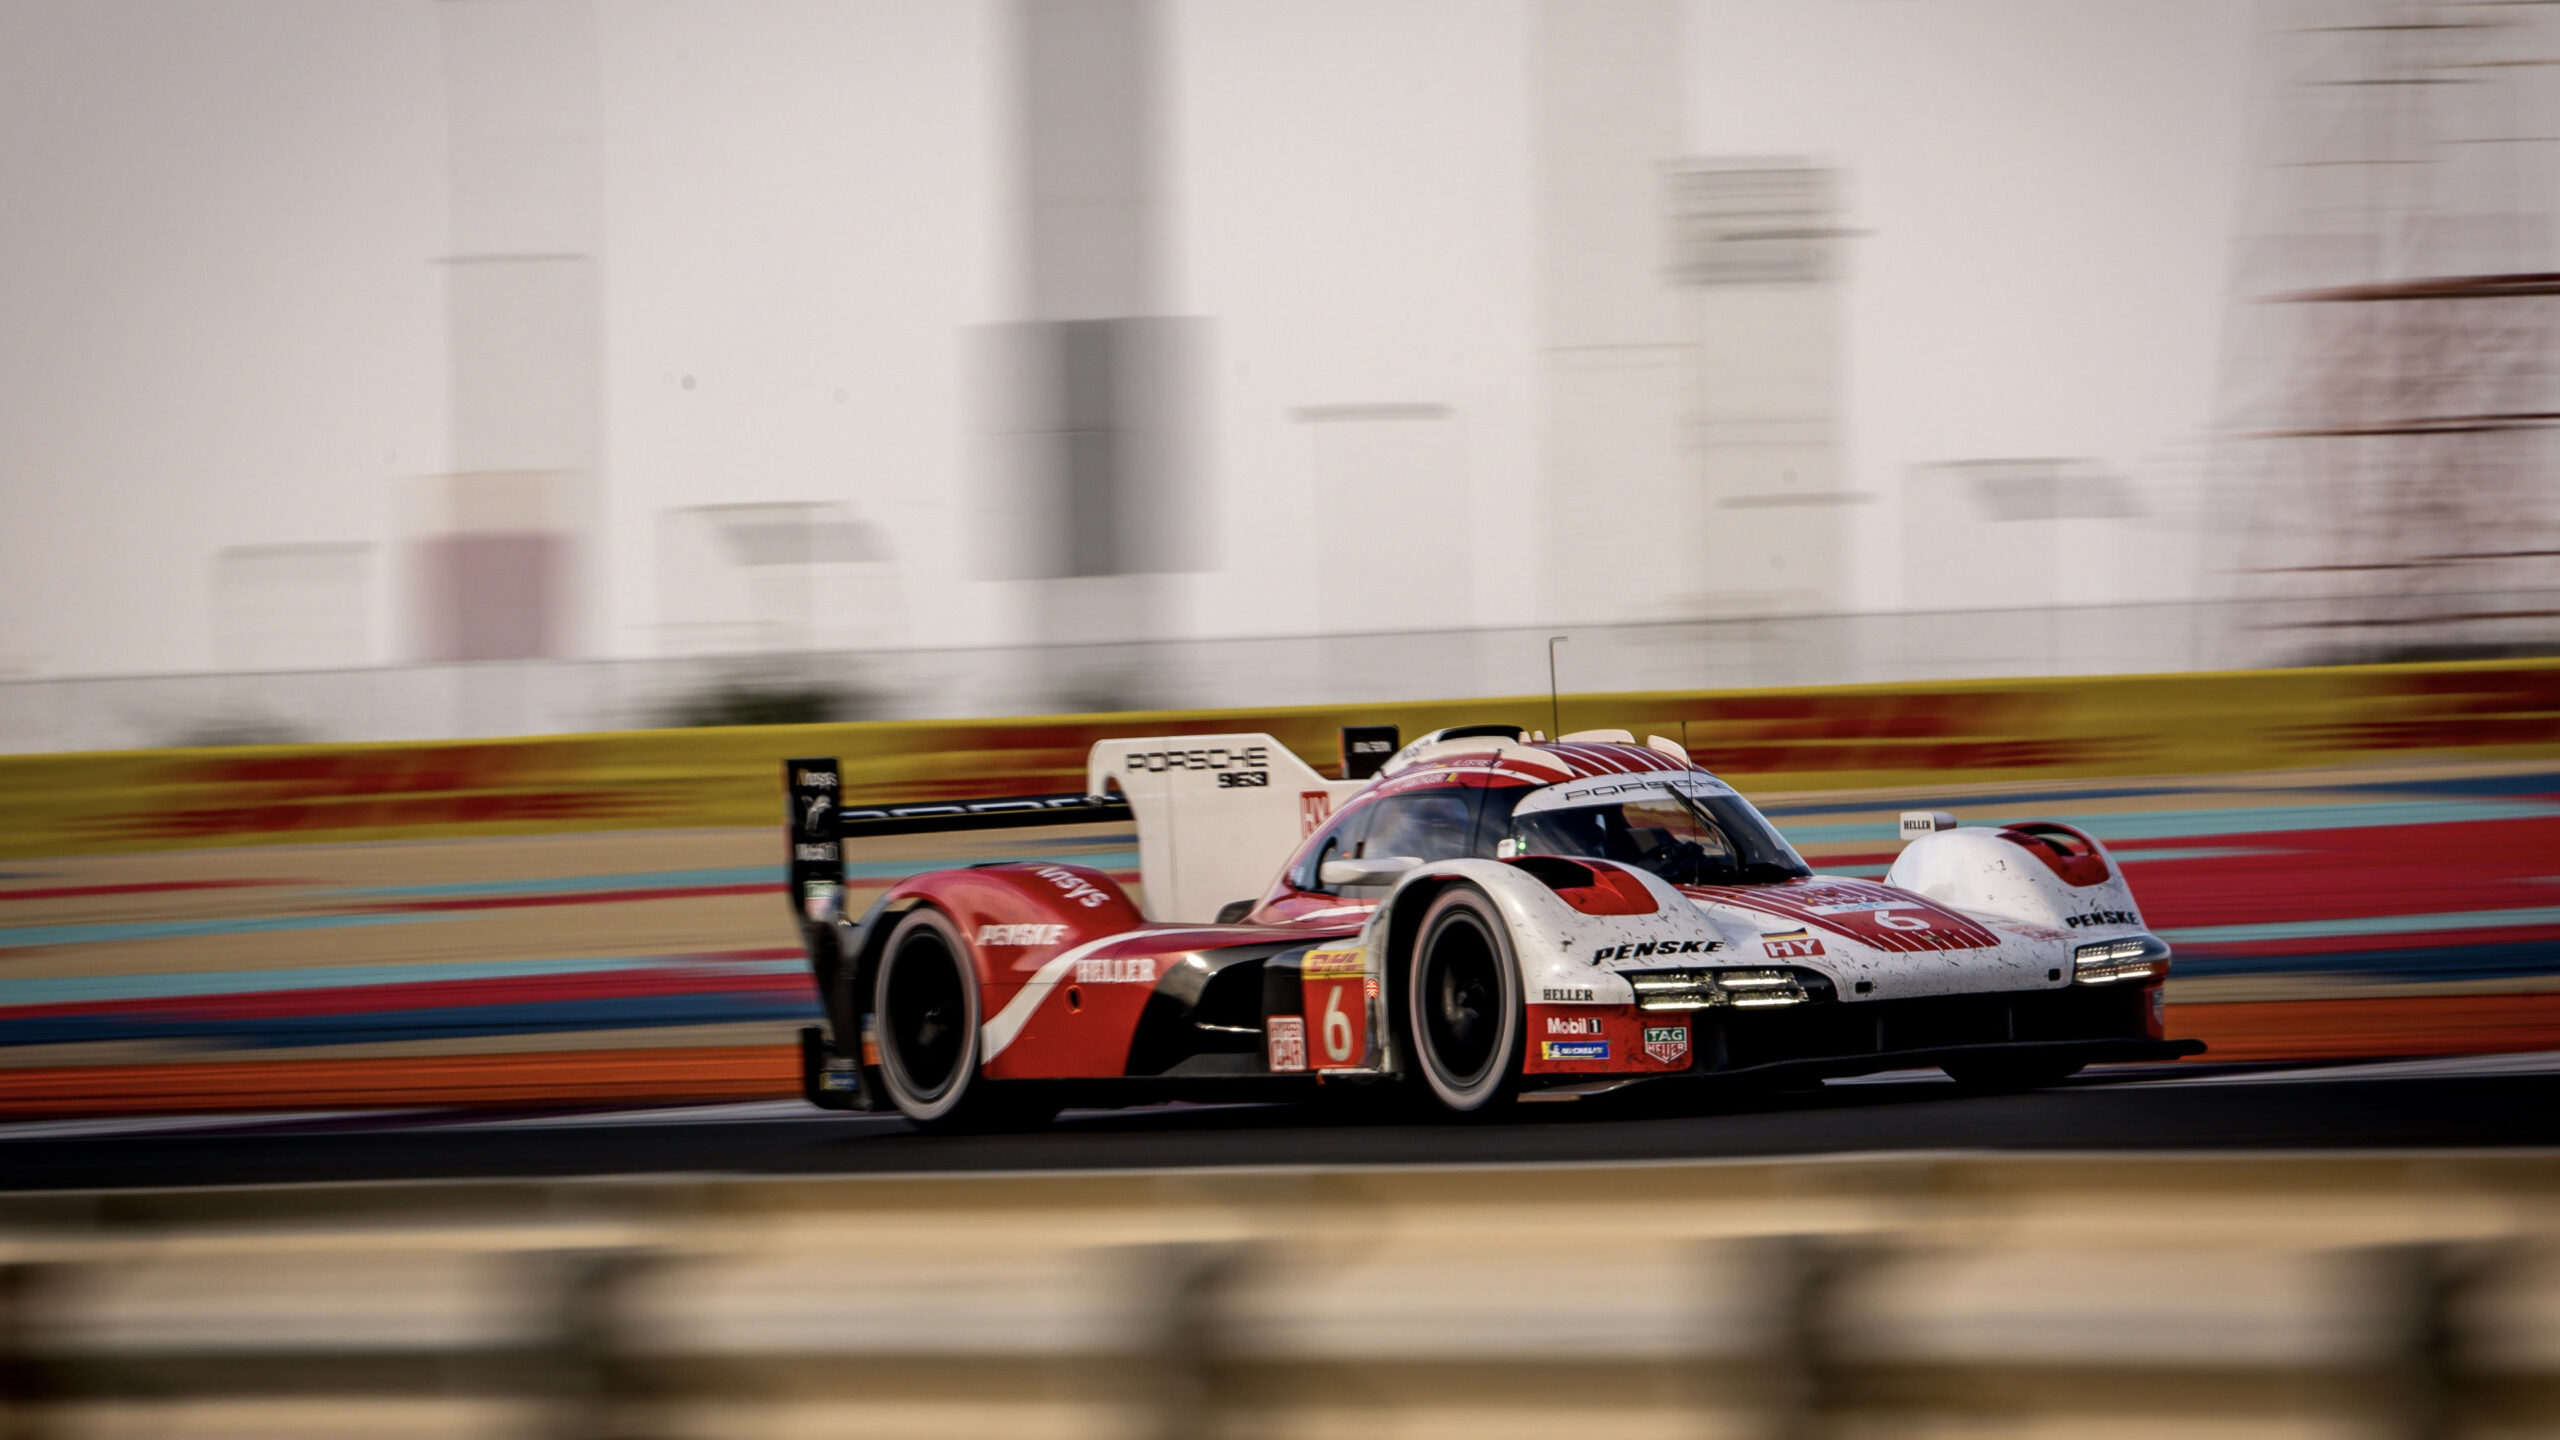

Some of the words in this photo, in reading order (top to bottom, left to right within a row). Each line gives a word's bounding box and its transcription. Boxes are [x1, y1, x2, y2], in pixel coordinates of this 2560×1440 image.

[1126, 747, 1268, 774] PORSCHE
[1218, 771, 1268, 788] 963
[1903, 820, 1931, 830] HELLER
[1875, 910, 1932, 931] 6
[2065, 911, 2139, 928] PENSKE
[1592, 940, 1724, 966] PENSKE
[1770, 941, 1818, 956] HY
[1075, 958, 1157, 983] HELLER
[1543, 988, 1594, 1001] HELLER
[1323, 984, 1353, 1062] 6
[1547, 1017, 1587, 1034] Mobil
[1649, 1030, 1683, 1041] TAG
[1647, 1043, 1685, 1063] HEUER
